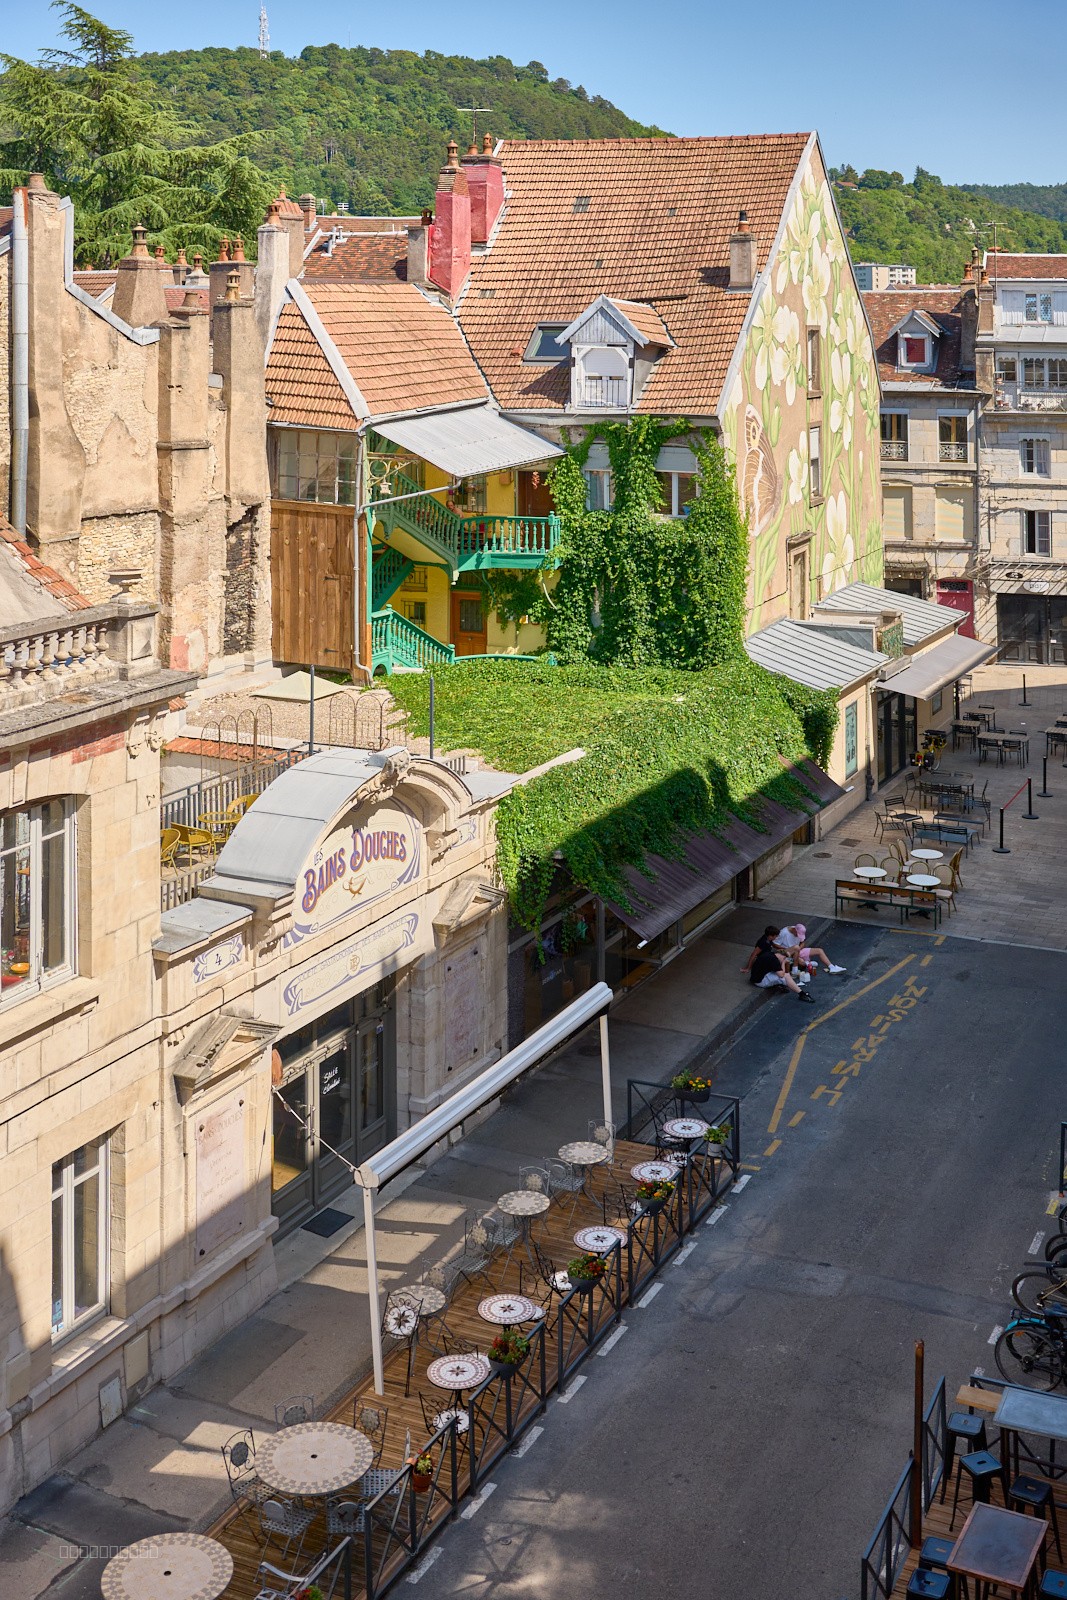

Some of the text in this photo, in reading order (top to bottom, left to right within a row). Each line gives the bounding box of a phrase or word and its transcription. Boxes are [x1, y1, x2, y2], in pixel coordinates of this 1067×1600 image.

[301, 828, 407, 914] BAINS DOUCHES
[215, 953, 222, 966] 4
[823, 985, 929, 1107] LIVRAISON
